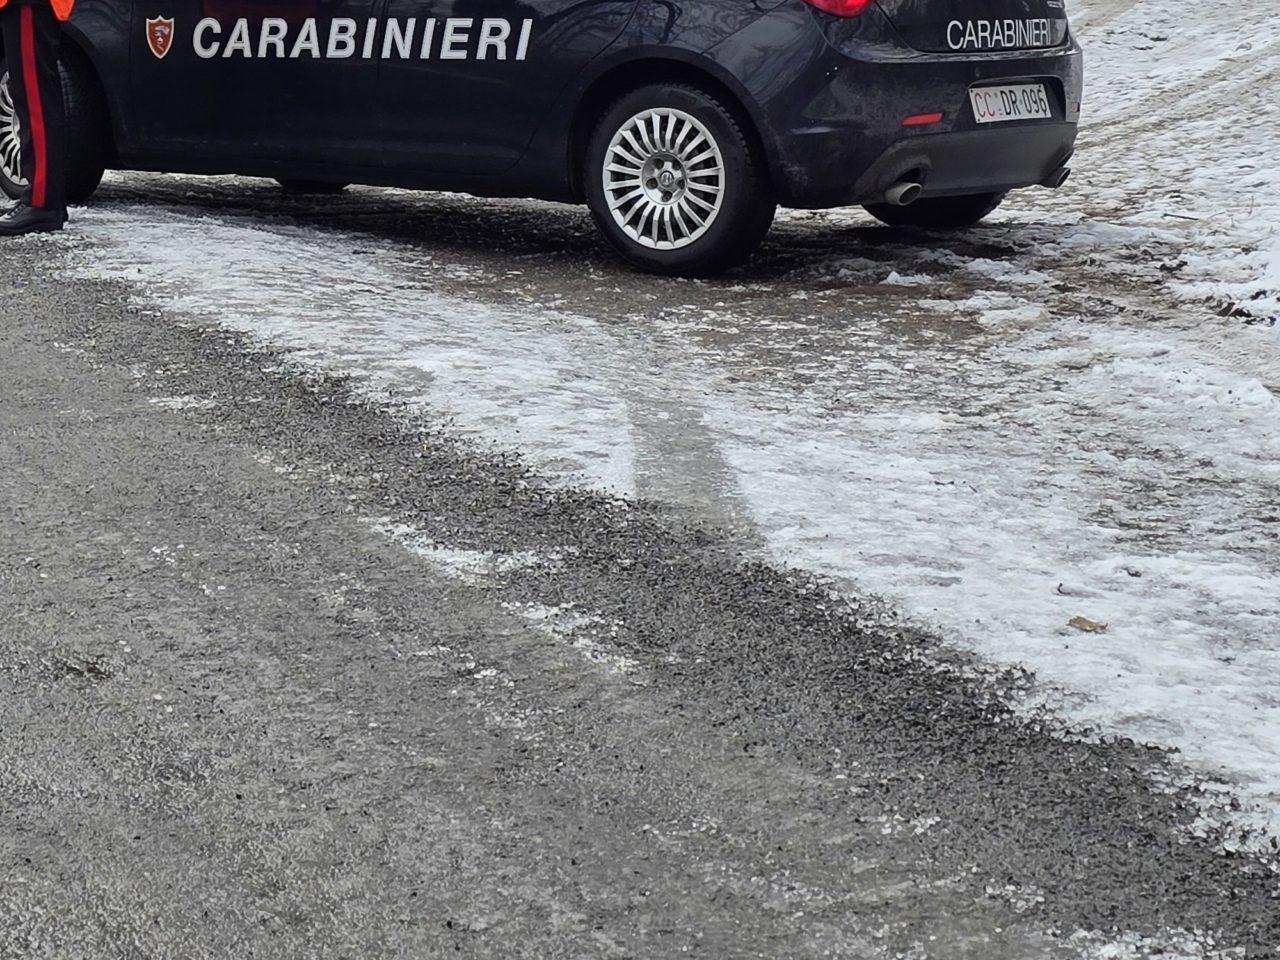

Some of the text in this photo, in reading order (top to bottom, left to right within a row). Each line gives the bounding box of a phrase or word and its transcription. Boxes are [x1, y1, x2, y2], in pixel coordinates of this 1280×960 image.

[192, 17, 533, 61] CARABINIERI
[946, 18, 1050, 50] CARABINIERI
[974, 88, 1048, 118] CC DR 096
